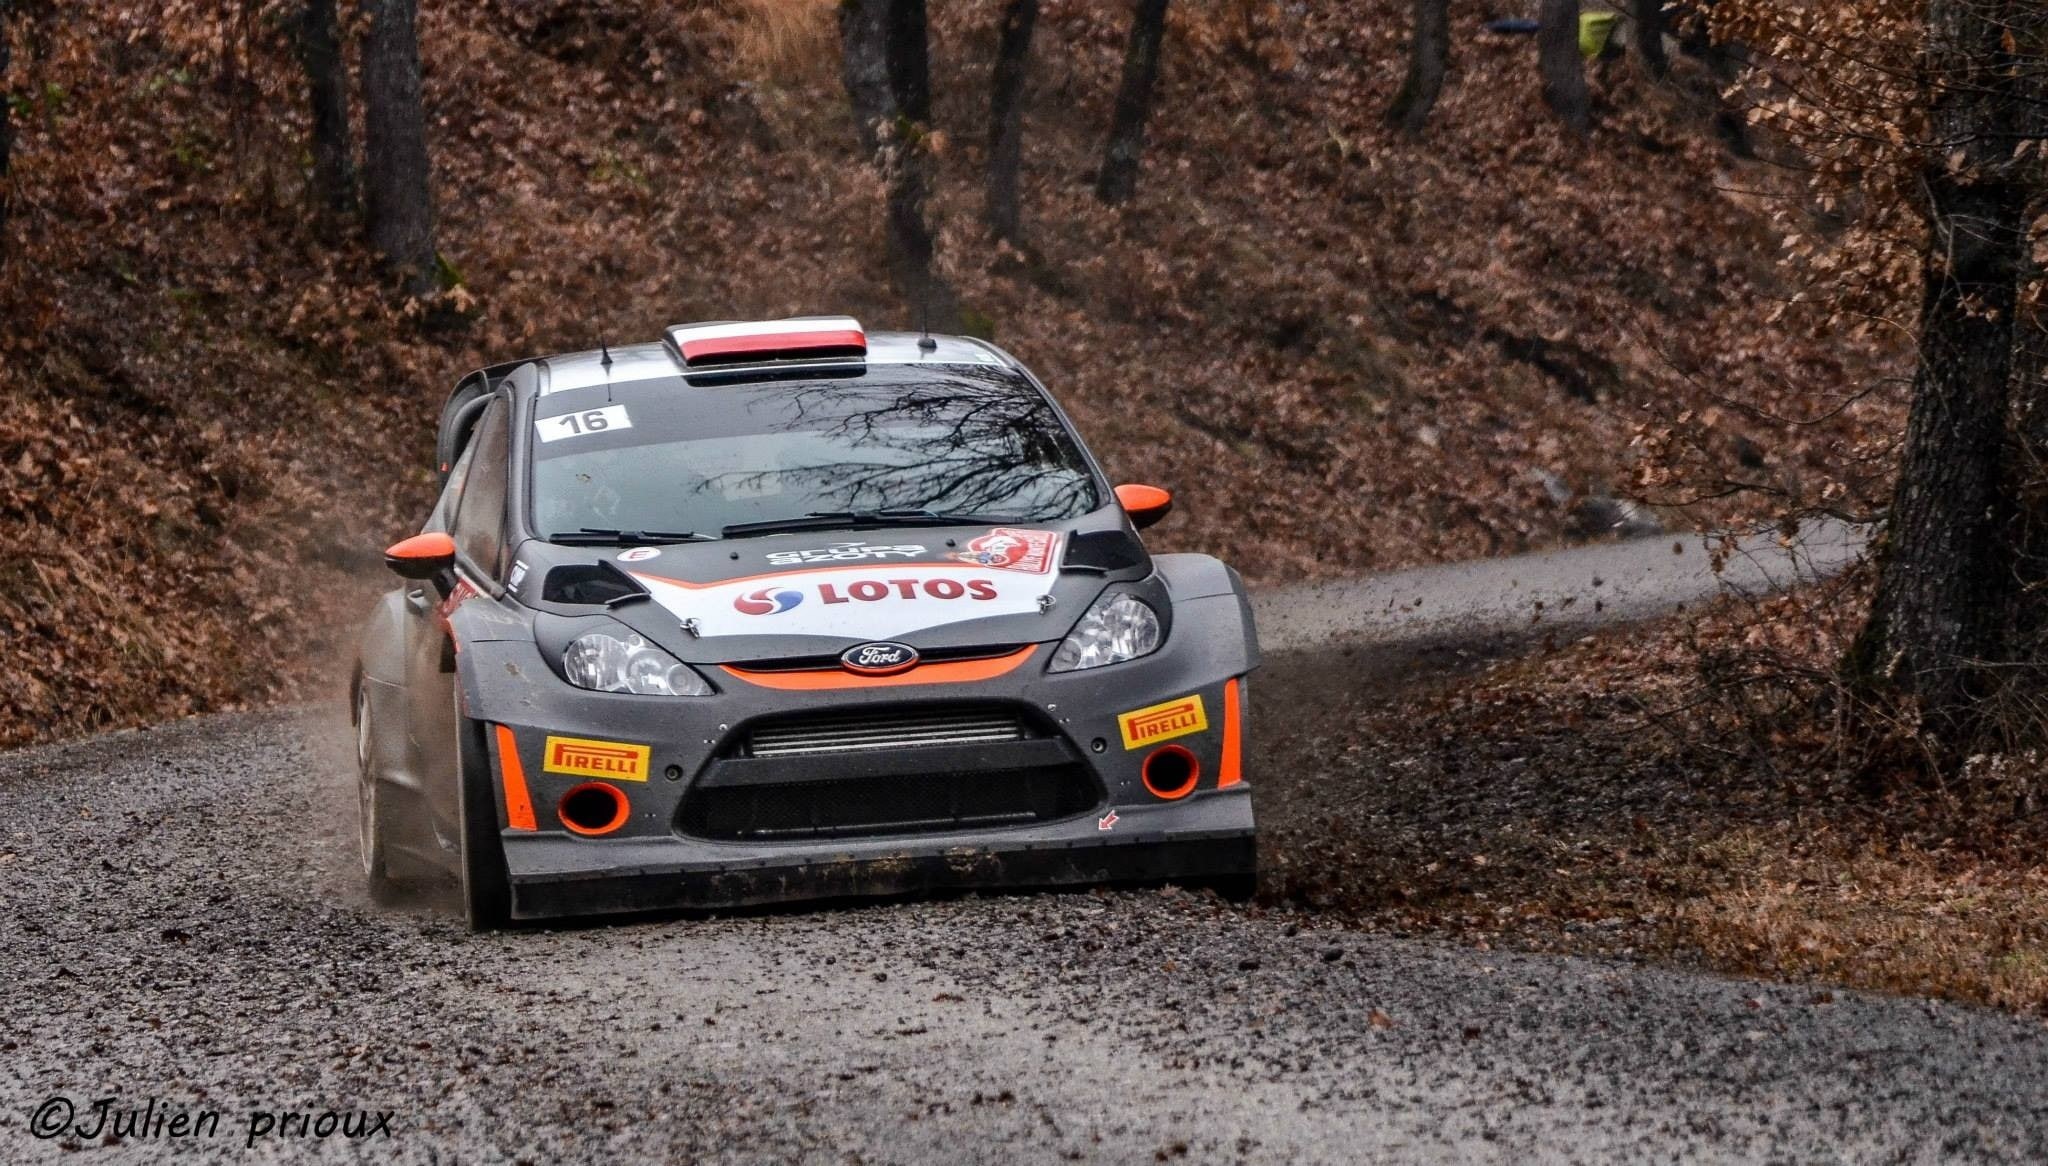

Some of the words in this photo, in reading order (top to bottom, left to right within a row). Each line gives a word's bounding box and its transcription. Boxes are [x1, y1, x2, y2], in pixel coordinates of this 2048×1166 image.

[558, 411, 608, 434] 16
[818, 578, 998, 605] LOTOS
[859, 646, 901, 665] Ford
[1127, 703, 1198, 741] PIRELLI
[553, 743, 639, 774] PIRELLI
